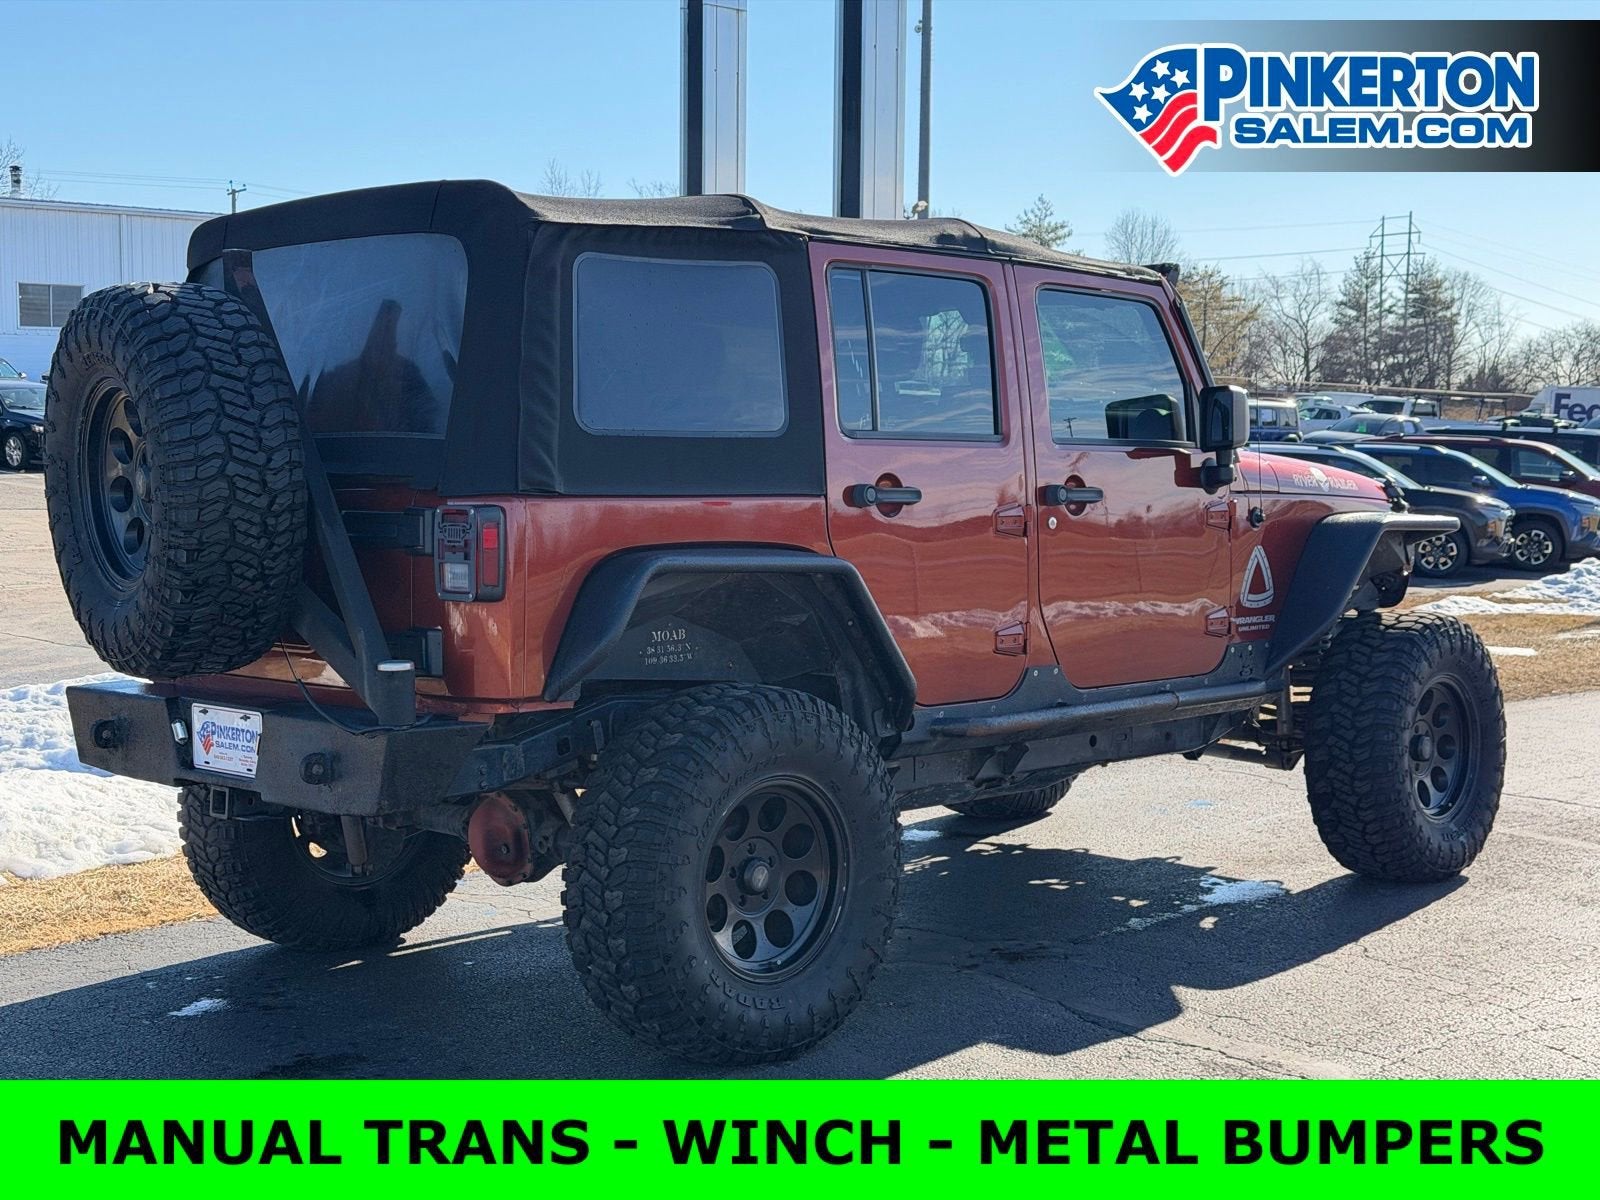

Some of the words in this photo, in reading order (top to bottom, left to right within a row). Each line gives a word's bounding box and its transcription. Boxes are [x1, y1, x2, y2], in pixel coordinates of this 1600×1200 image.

[1230, 614, 1276, 625] WRANGLER
[1238, 623, 1271, 632] UNLIMITED
[651, 628, 686, 643] MOAB
[210, 721, 258, 745] PINKERTON
